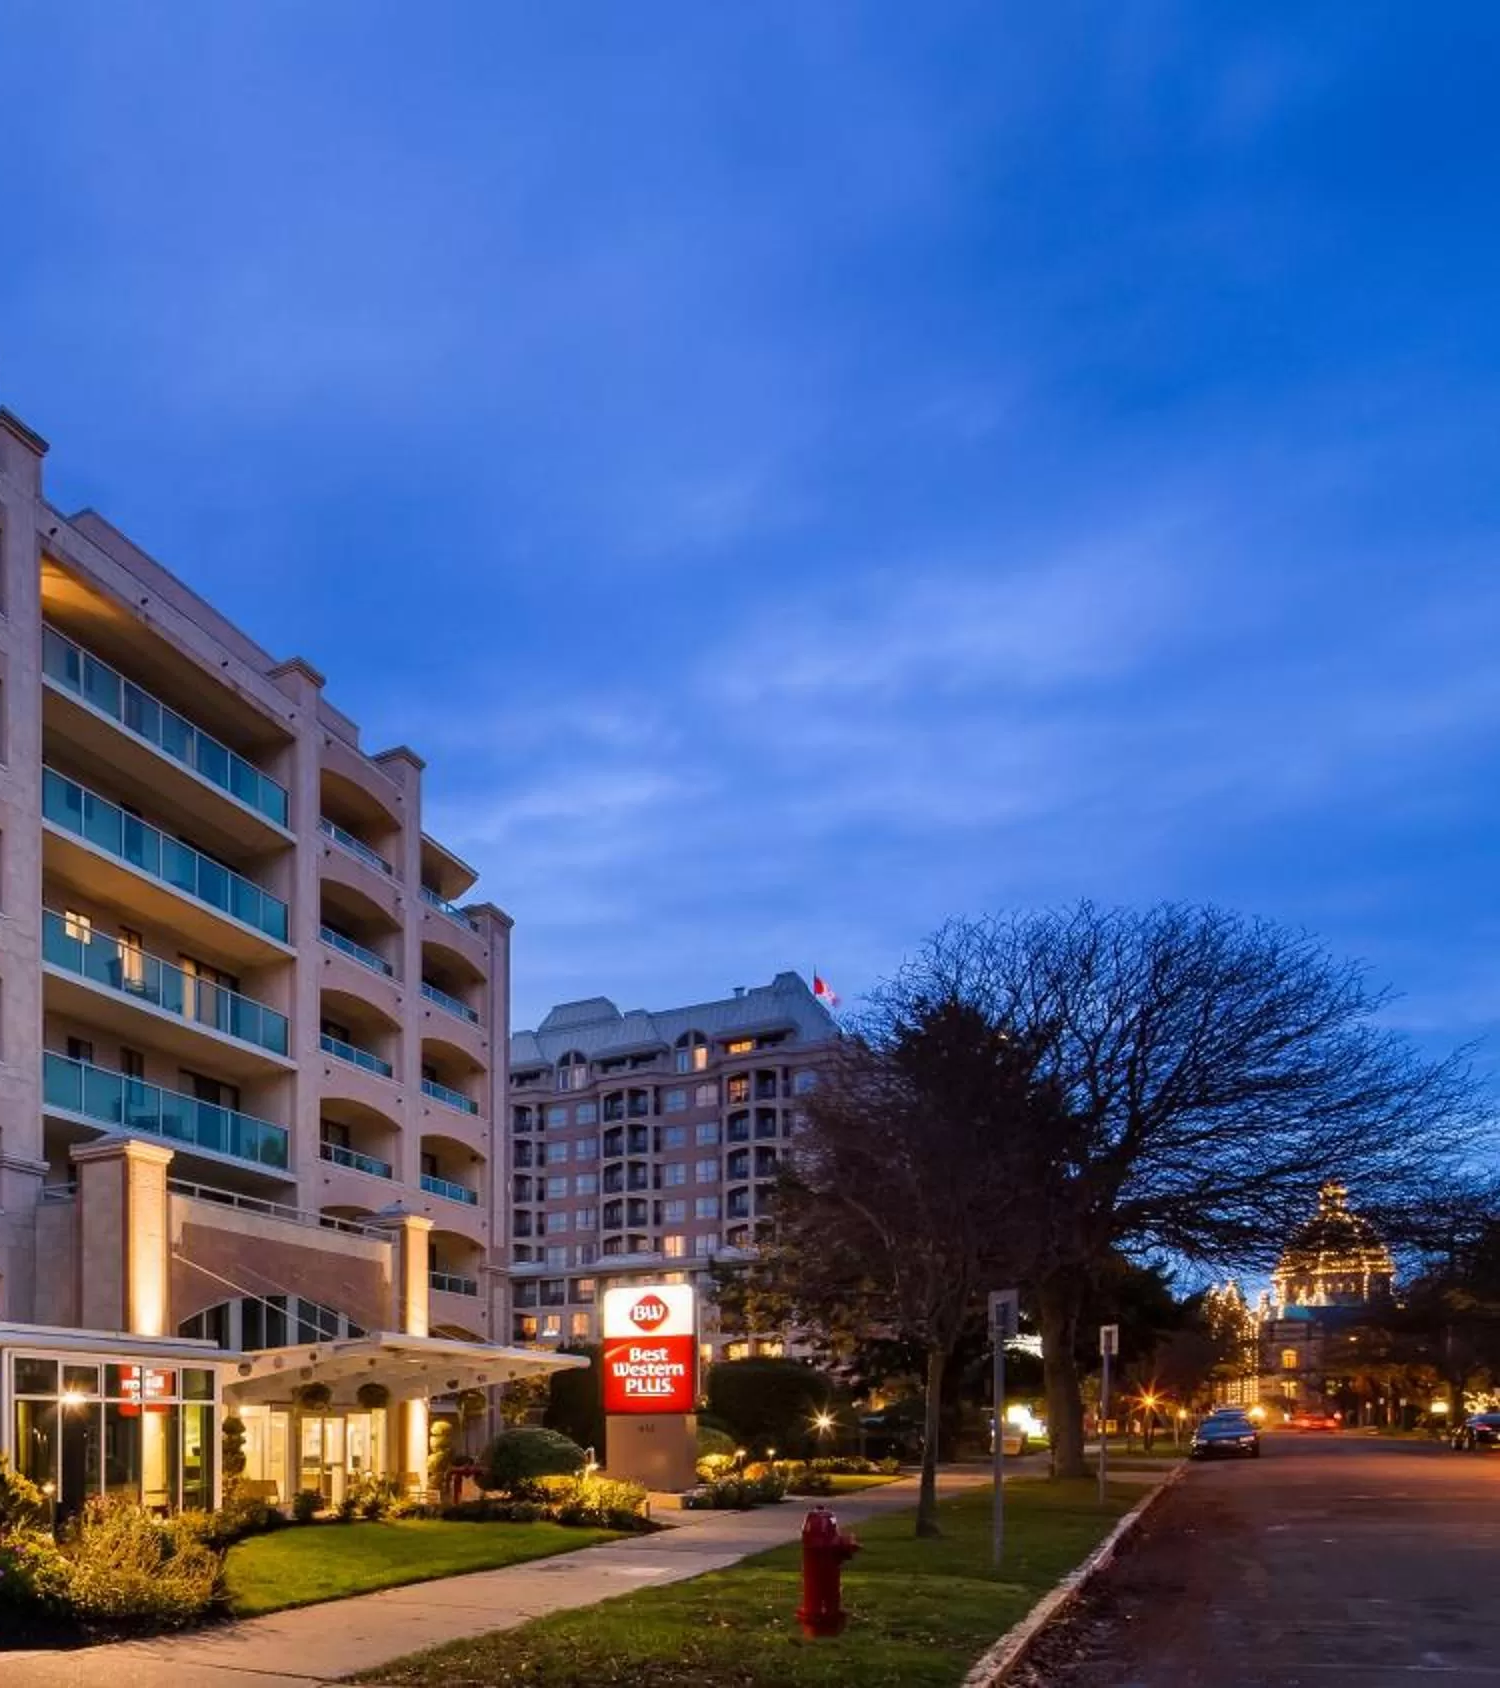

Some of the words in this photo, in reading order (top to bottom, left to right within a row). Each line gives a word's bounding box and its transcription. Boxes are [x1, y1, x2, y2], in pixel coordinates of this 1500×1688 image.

[633, 1304, 665, 1321] BW
[629, 1347, 668, 1361] Best
[612, 1362, 684, 1376] Western
